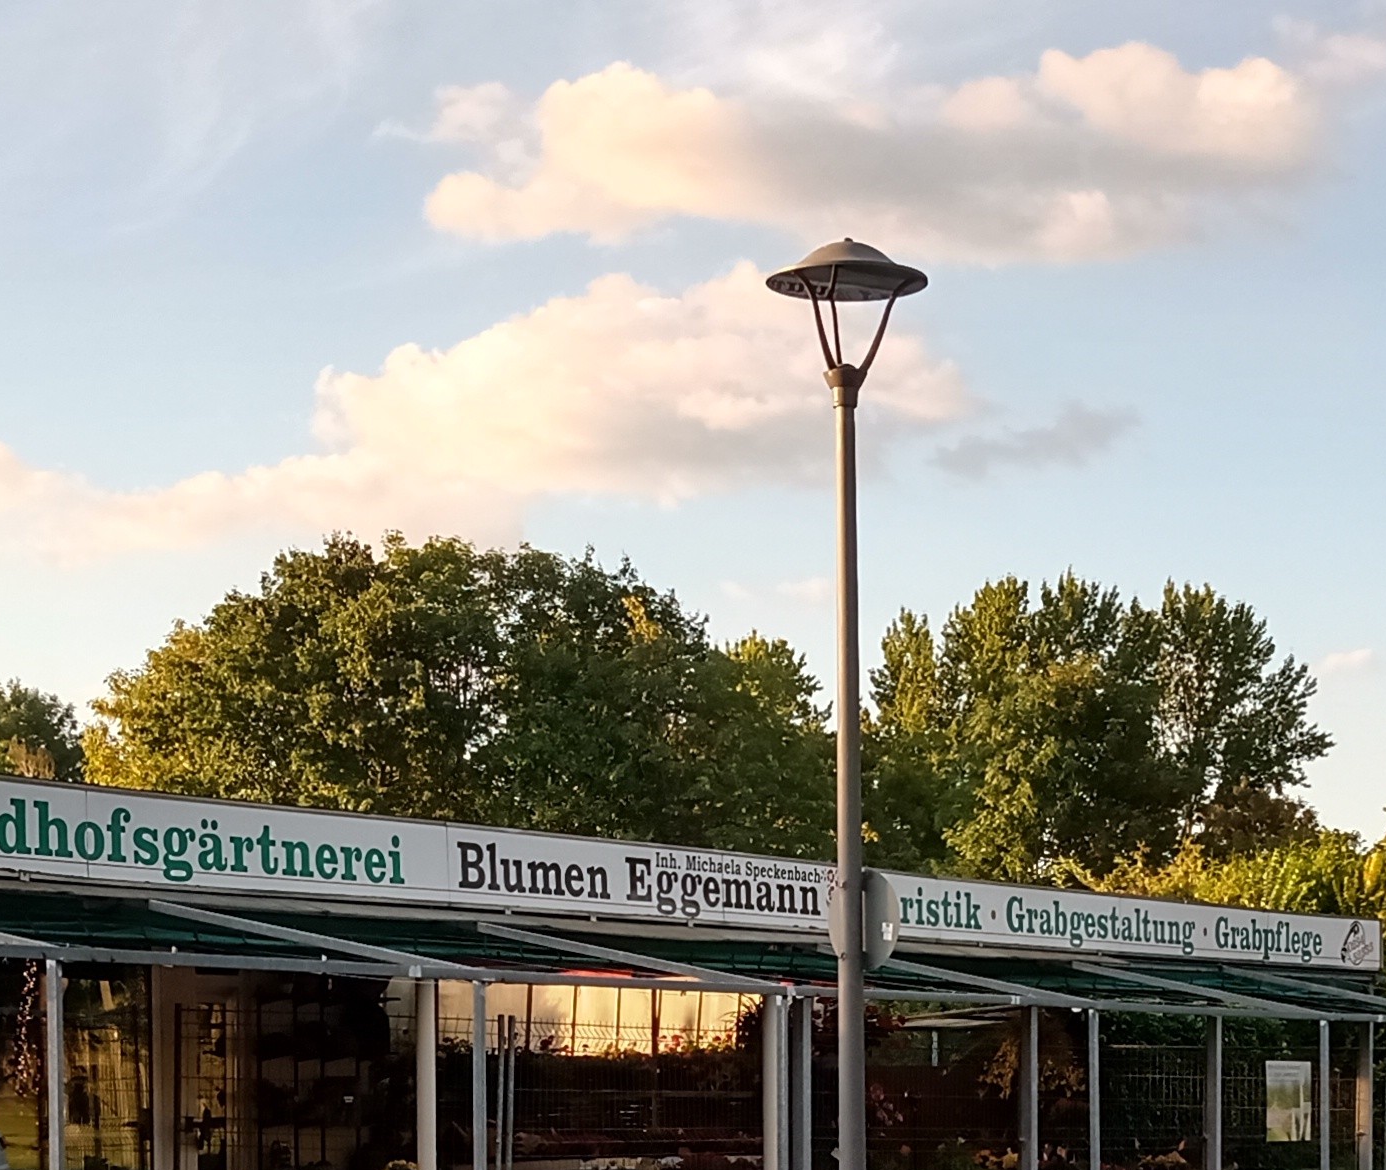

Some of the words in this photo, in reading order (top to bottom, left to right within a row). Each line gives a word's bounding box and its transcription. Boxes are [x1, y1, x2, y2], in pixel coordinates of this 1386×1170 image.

[456, 841, 611, 900] Blumen
[624, 857, 821, 918] Eggemann
[655, 851, 682, 871] Inh.
[686, 855, 742, 876] Michaela
[745, 861, 821, 884] Speckenbach
[899, 887, 983, 931] ristik
[1006, 895, 1196, 955] Grabgestaltung
[1215, 915, 1323, 964] Grabpflege
